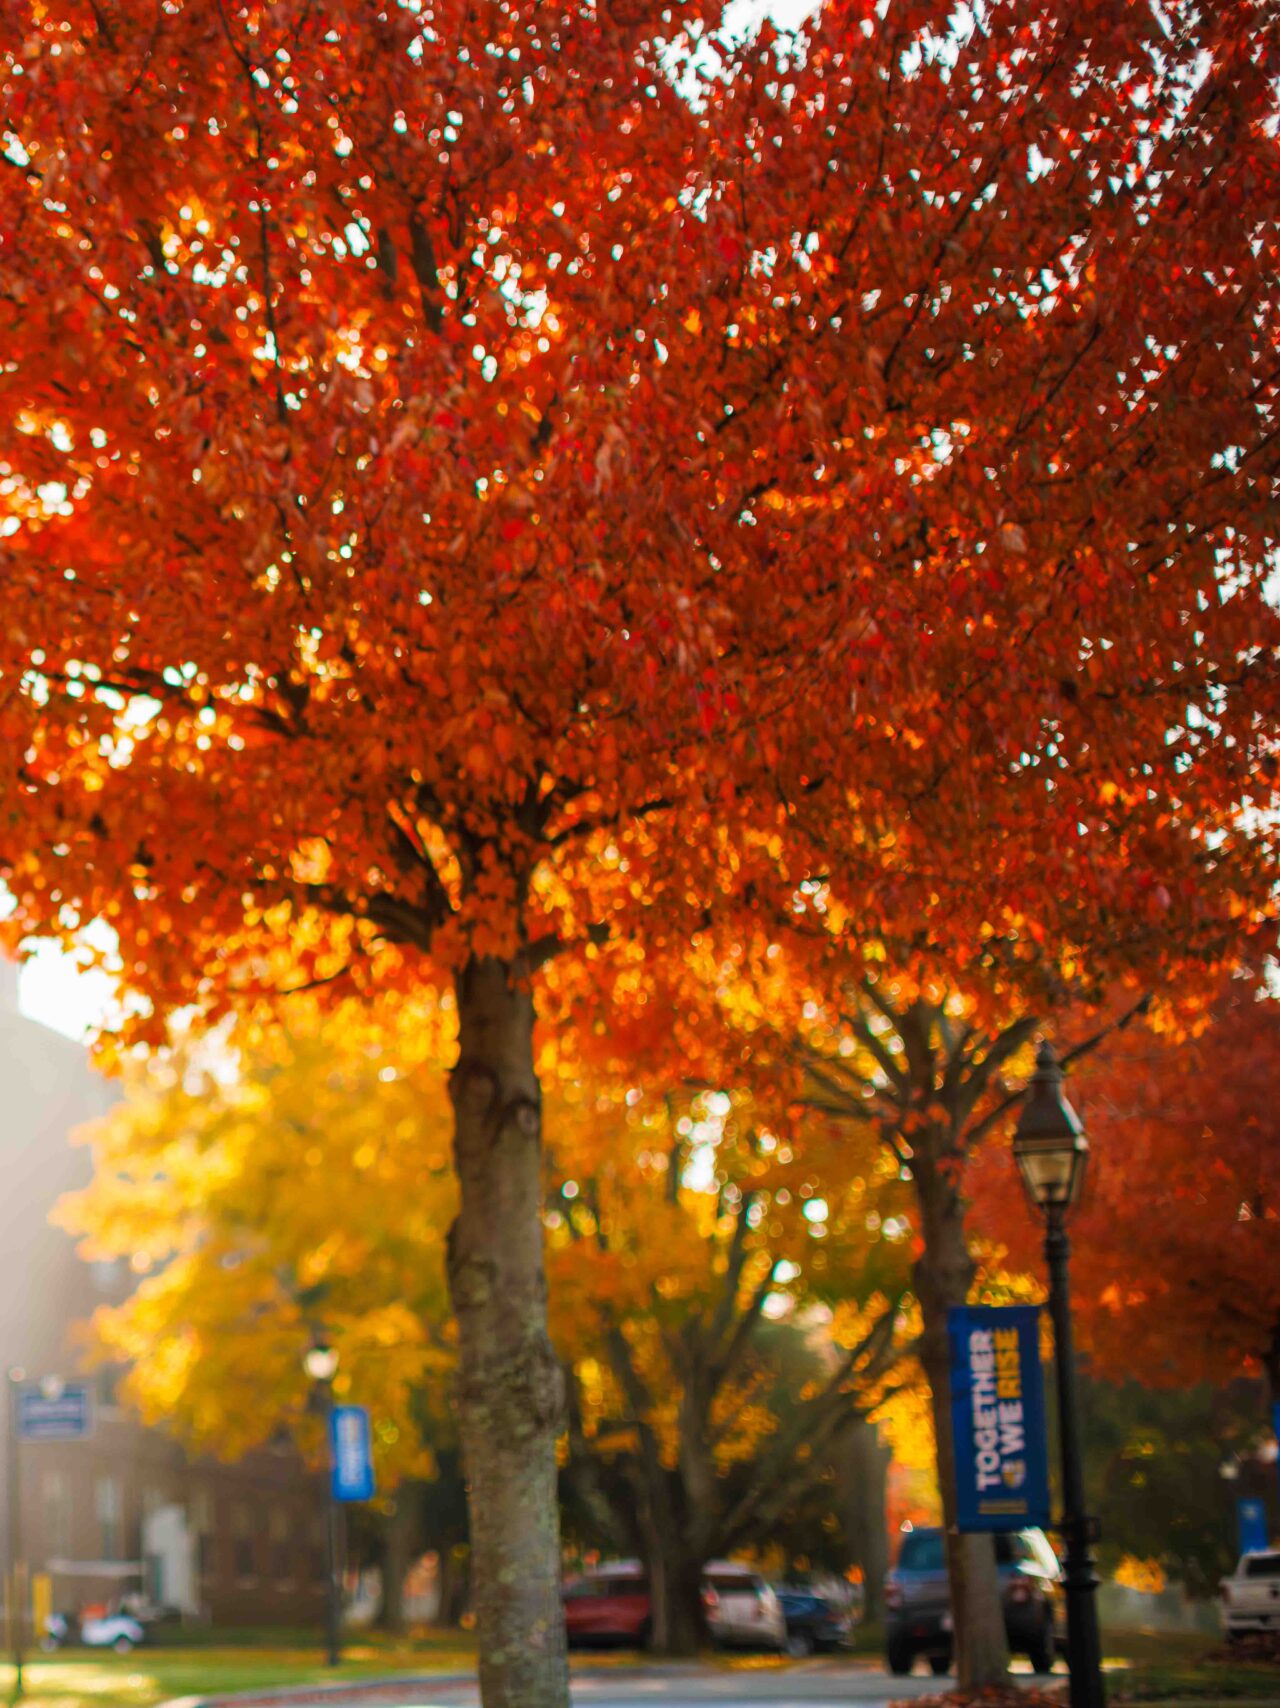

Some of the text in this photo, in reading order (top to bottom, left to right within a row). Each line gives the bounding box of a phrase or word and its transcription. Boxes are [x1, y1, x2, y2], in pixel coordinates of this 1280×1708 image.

[969, 1329, 1001, 1491] TOGETHER
[994, 1328, 1024, 1455] WE RISE
